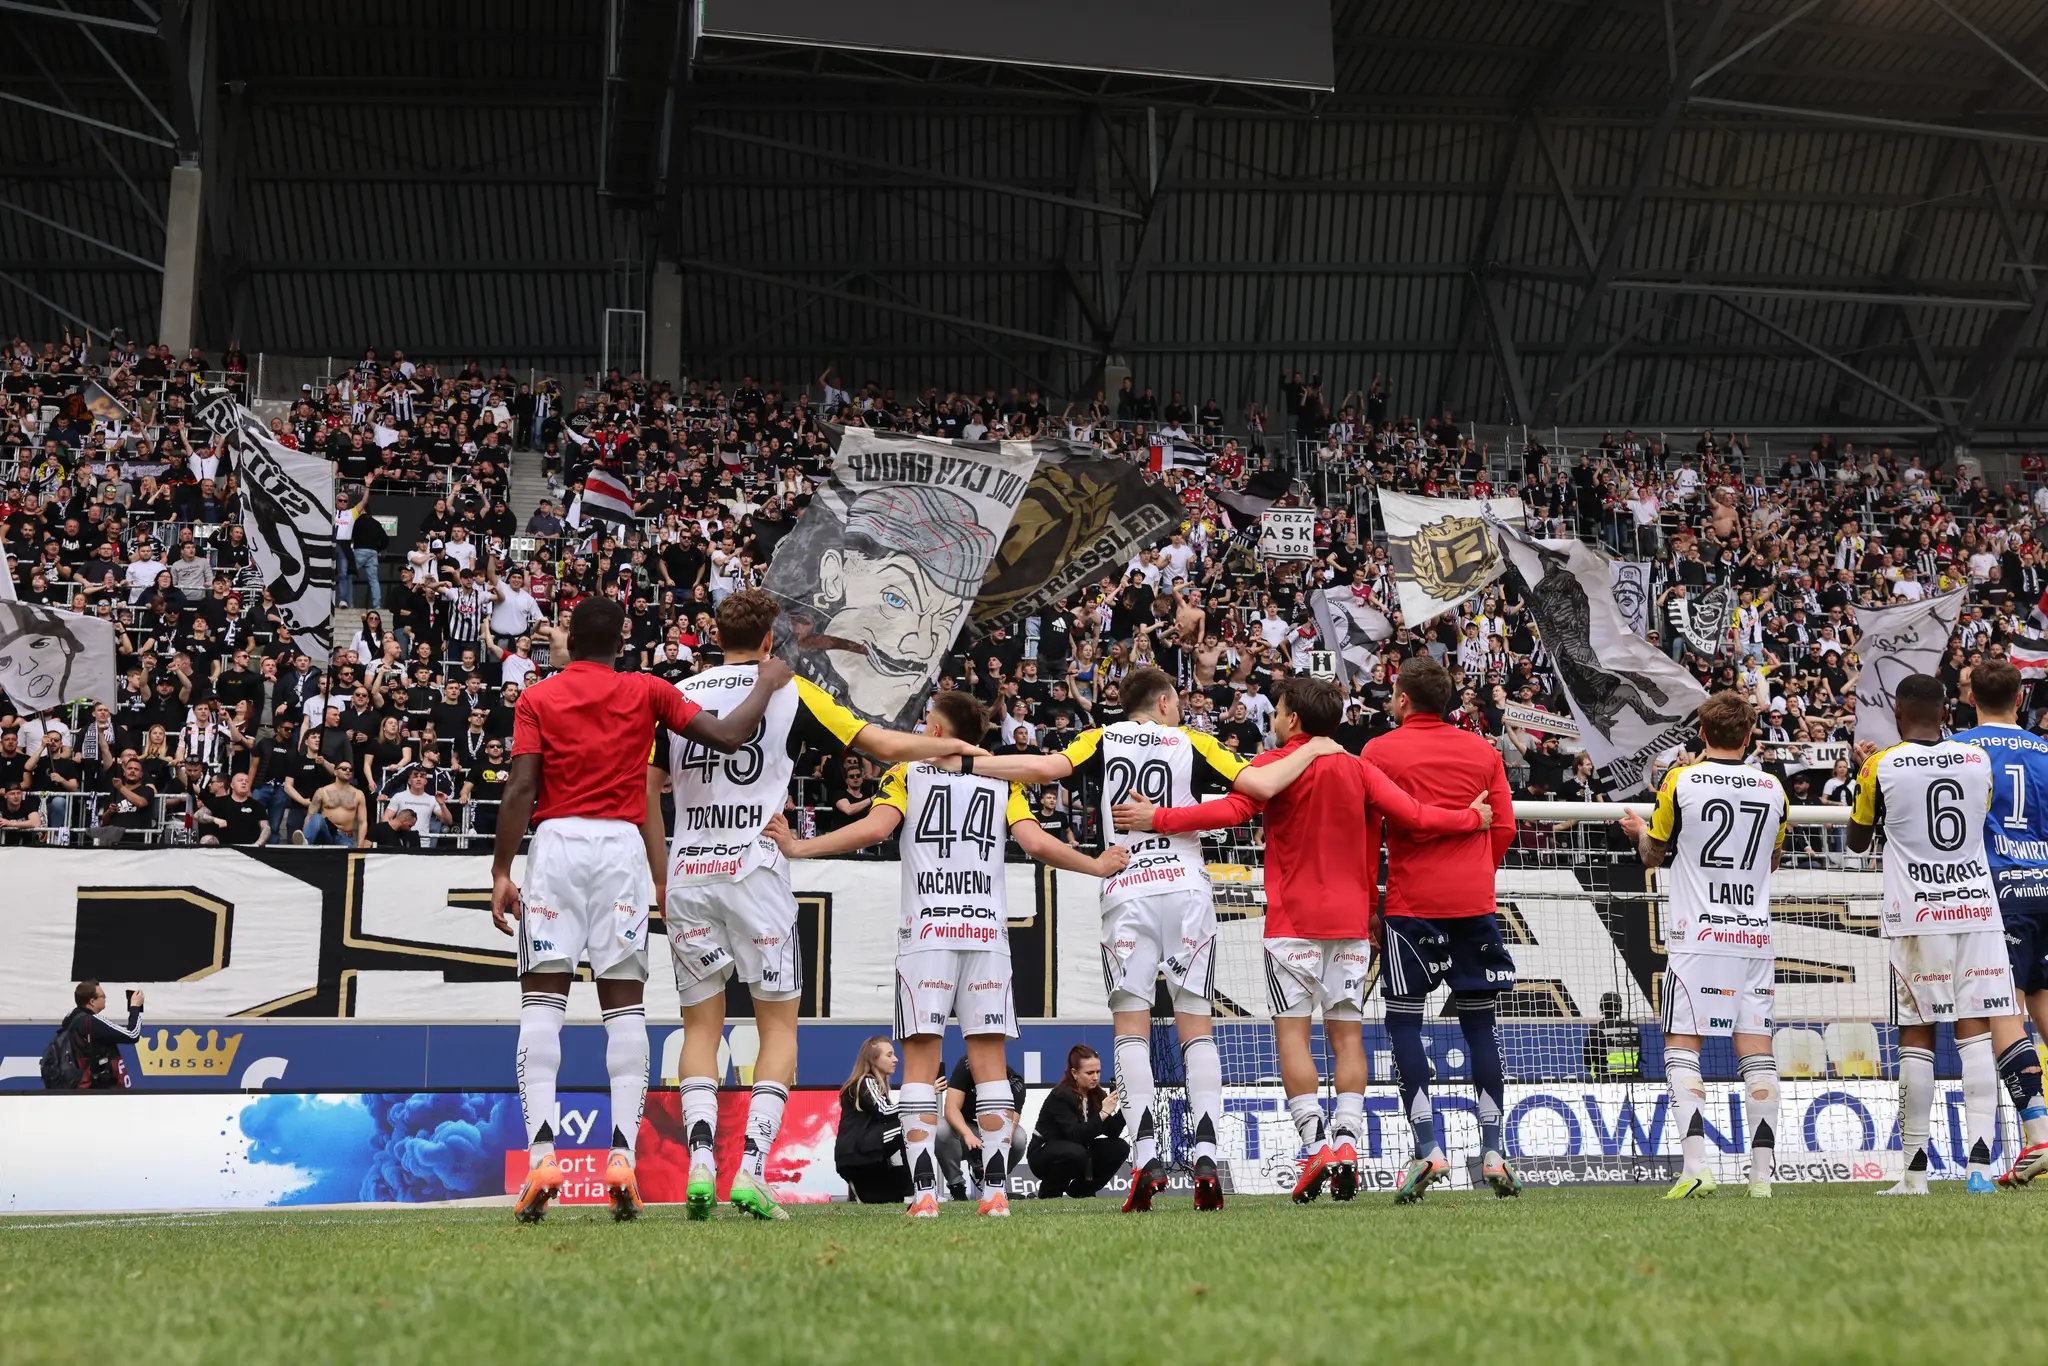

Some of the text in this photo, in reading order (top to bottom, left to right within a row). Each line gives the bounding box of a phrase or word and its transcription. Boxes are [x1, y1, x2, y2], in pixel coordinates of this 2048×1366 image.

[1263, 513, 1312, 523] FORZA
[1262, 526, 1313, 541] ASK
[1275, 544, 1309, 553] 1908
[684, 674, 756, 692] energie
[1104, 730, 1180, 747] energieAG
[681, 709, 767, 787] 43
[1817, 747, 1847, 761] LIVE
[1893, 752, 1982, 769] energieAG
[1691, 773, 1774, 790] energieAG
[1106, 756, 1173, 835] 29
[2003, 764, 2028, 830] 1
[914, 784, 997, 862] 44
[1926, 778, 1966, 852] 6
[1699, 798, 1771, 871] 27
[685, 856, 743, 876] windhag
[1119, 866, 1186, 888] windhager
[1709, 882, 1755, 906] LANG
[1915, 887, 1991, 903] ASPÖCK
[920, 904, 997, 921] ASPÖCK
[1698, 913, 1769, 927] ASPÖCK
[1931, 904, 1993, 923] windhager
[935, 922, 998, 943] windhager
[700, 946, 726, 967] BWT
[762, 969, 780, 982] WT
[1497, 970, 1516, 982] BW
[1984, 996, 2010, 1009] BWT
[158, 1058, 214, 1068] 1858
[553, 1101, 599, 1145] ky
[559, 1153, 597, 1173] ort
[1512, 1164, 1672, 1186] nergie. Aber Gut.
